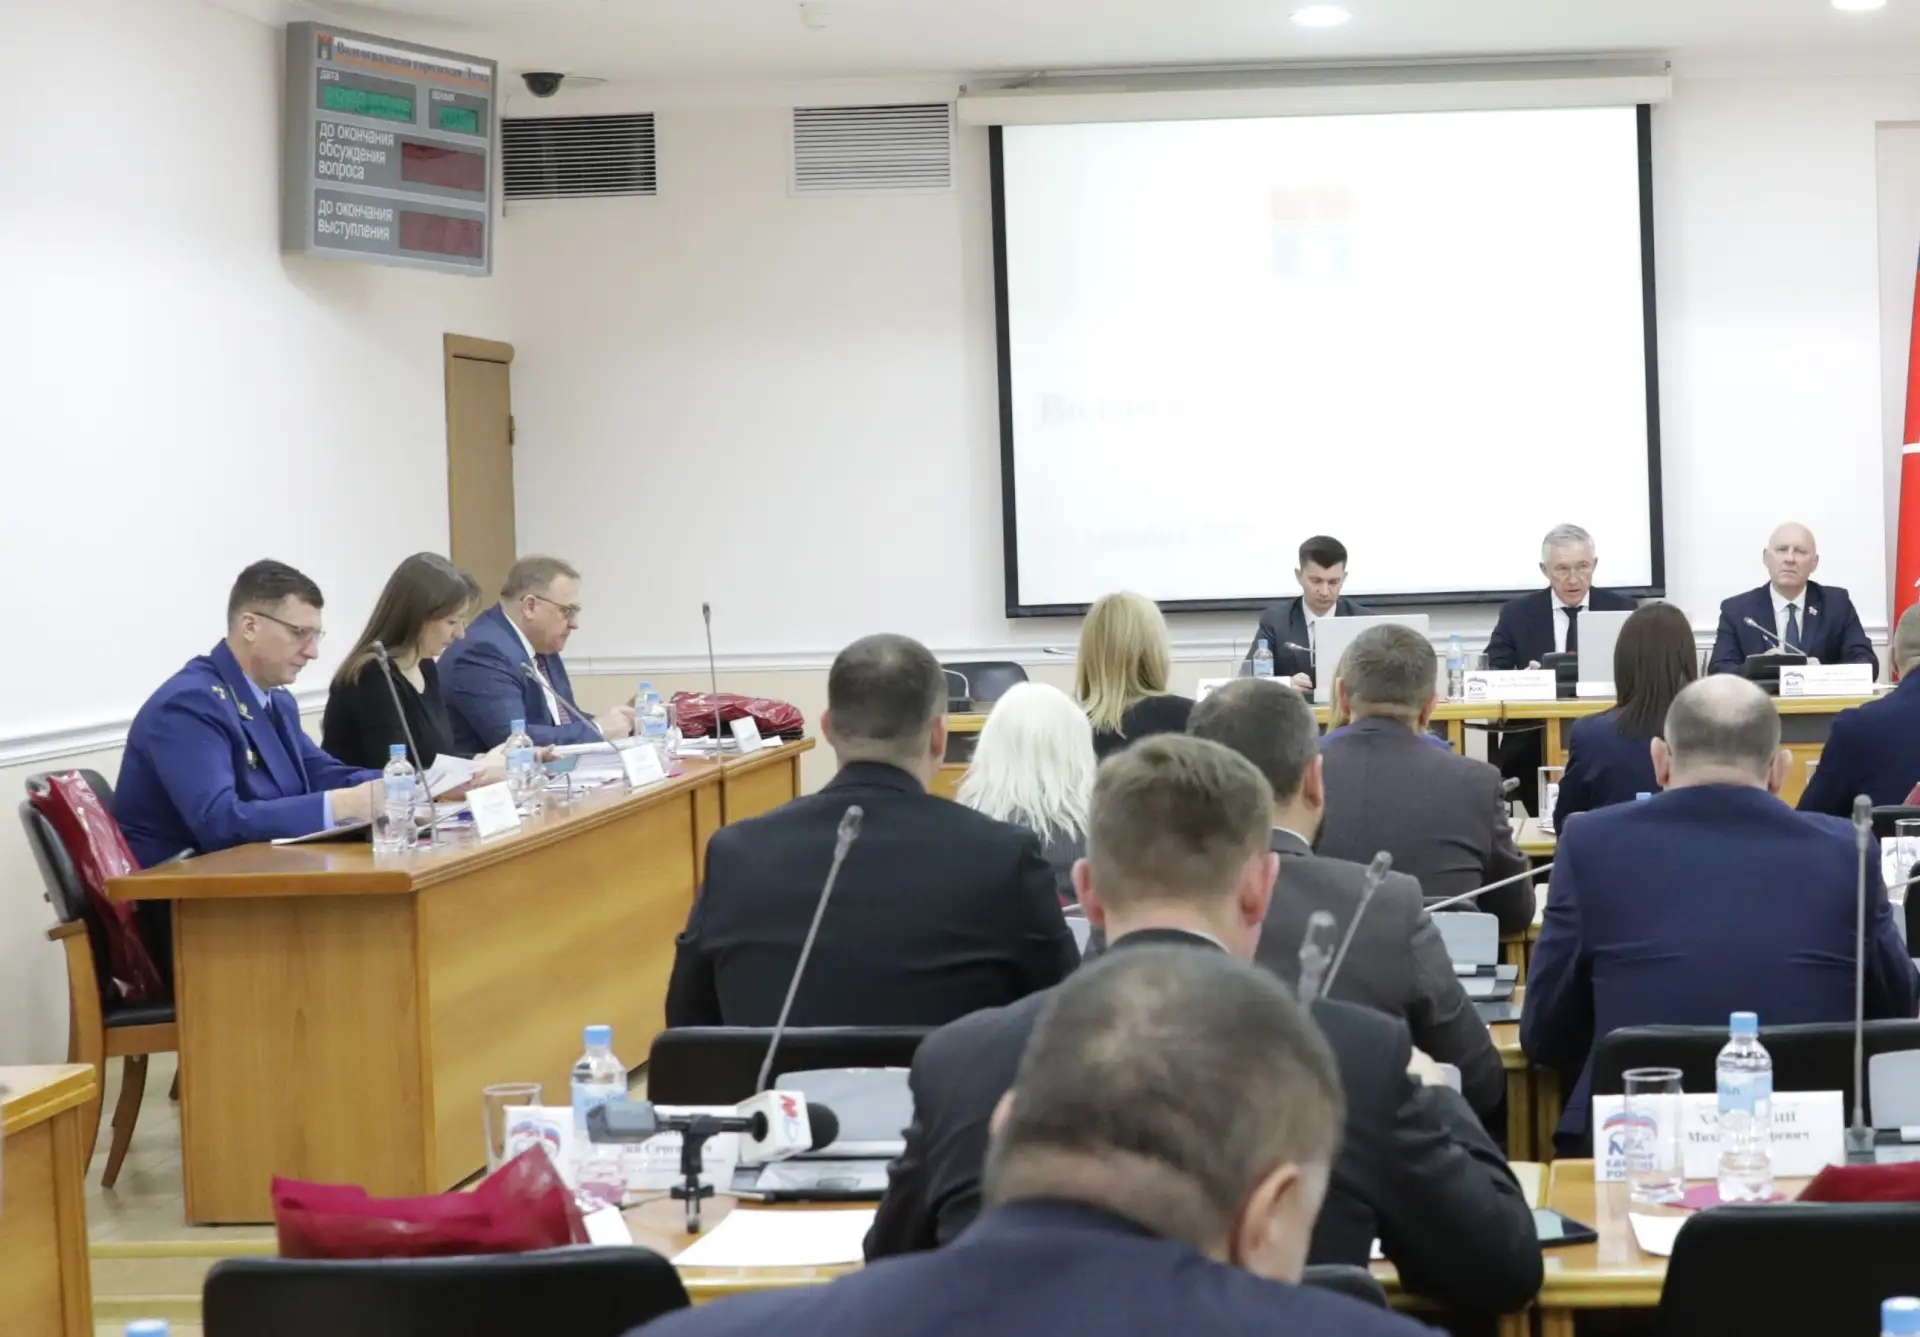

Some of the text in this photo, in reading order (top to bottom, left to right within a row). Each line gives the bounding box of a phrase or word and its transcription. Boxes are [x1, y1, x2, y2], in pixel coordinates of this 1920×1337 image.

[319, 122, 394, 147] до окончания
[319, 138, 386, 164] обсуждения
[318, 160, 364, 180] вопроса
[318, 199, 392, 221] до окончания
[318, 218, 389, 240] выступления
